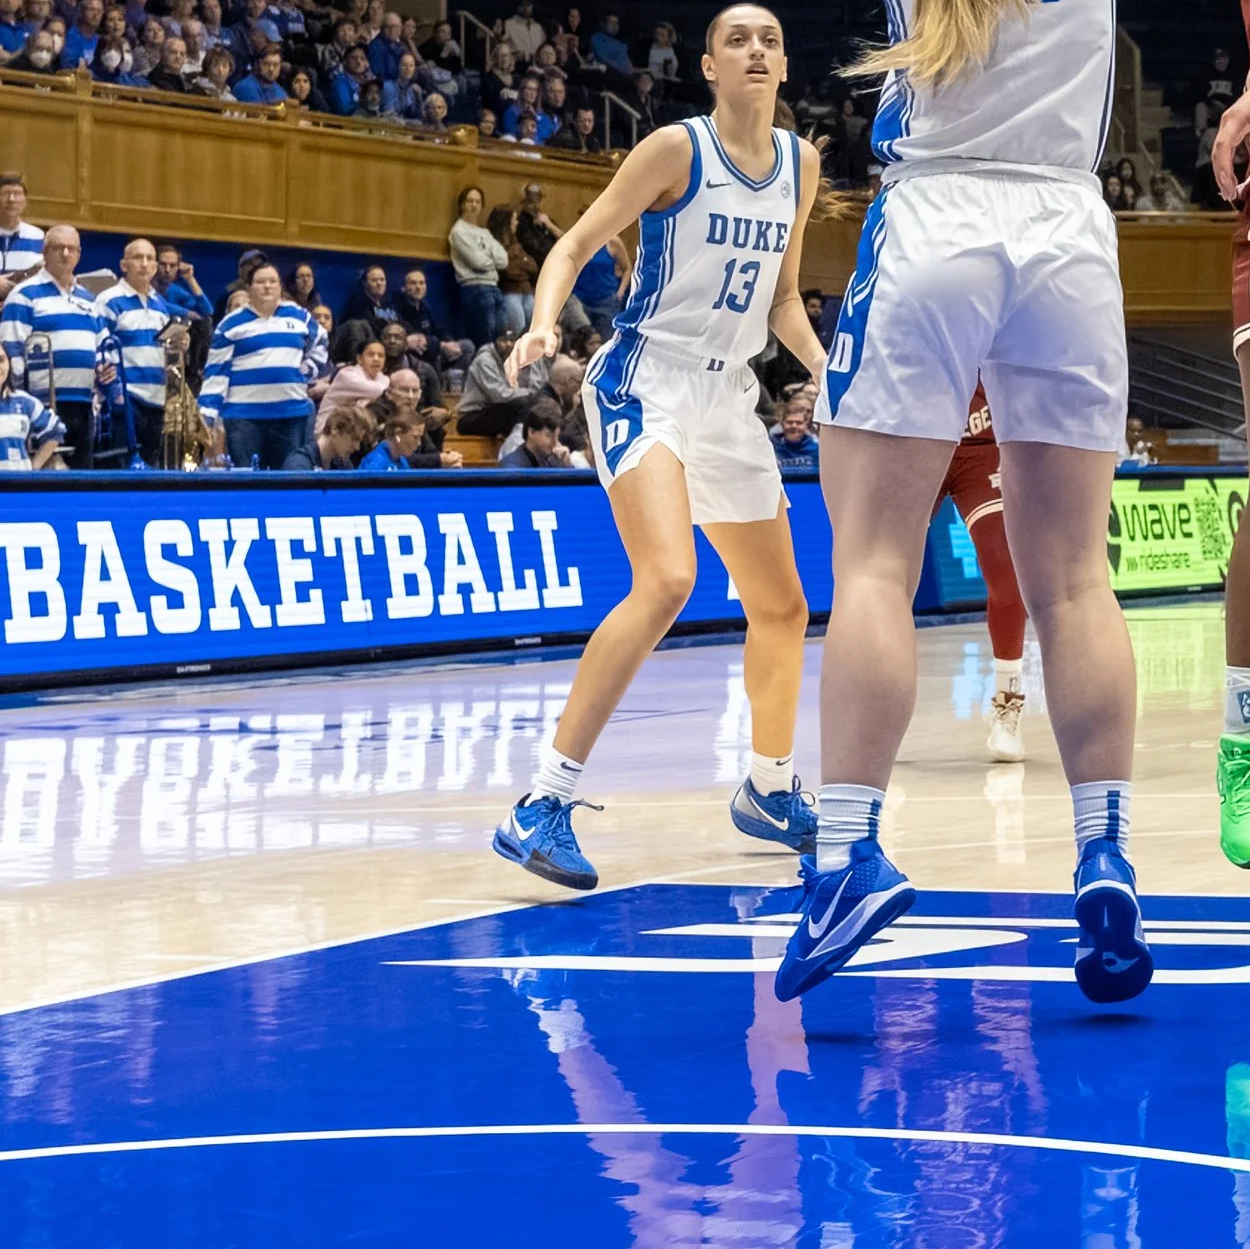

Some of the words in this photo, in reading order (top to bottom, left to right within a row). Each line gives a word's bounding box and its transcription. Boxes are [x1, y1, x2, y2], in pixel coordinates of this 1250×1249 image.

[706, 212, 788, 253] DUKE
[712, 258, 761, 314] 13
[1122, 503, 1193, 542] wave
[0, 510, 584, 645] BASKETBALL
